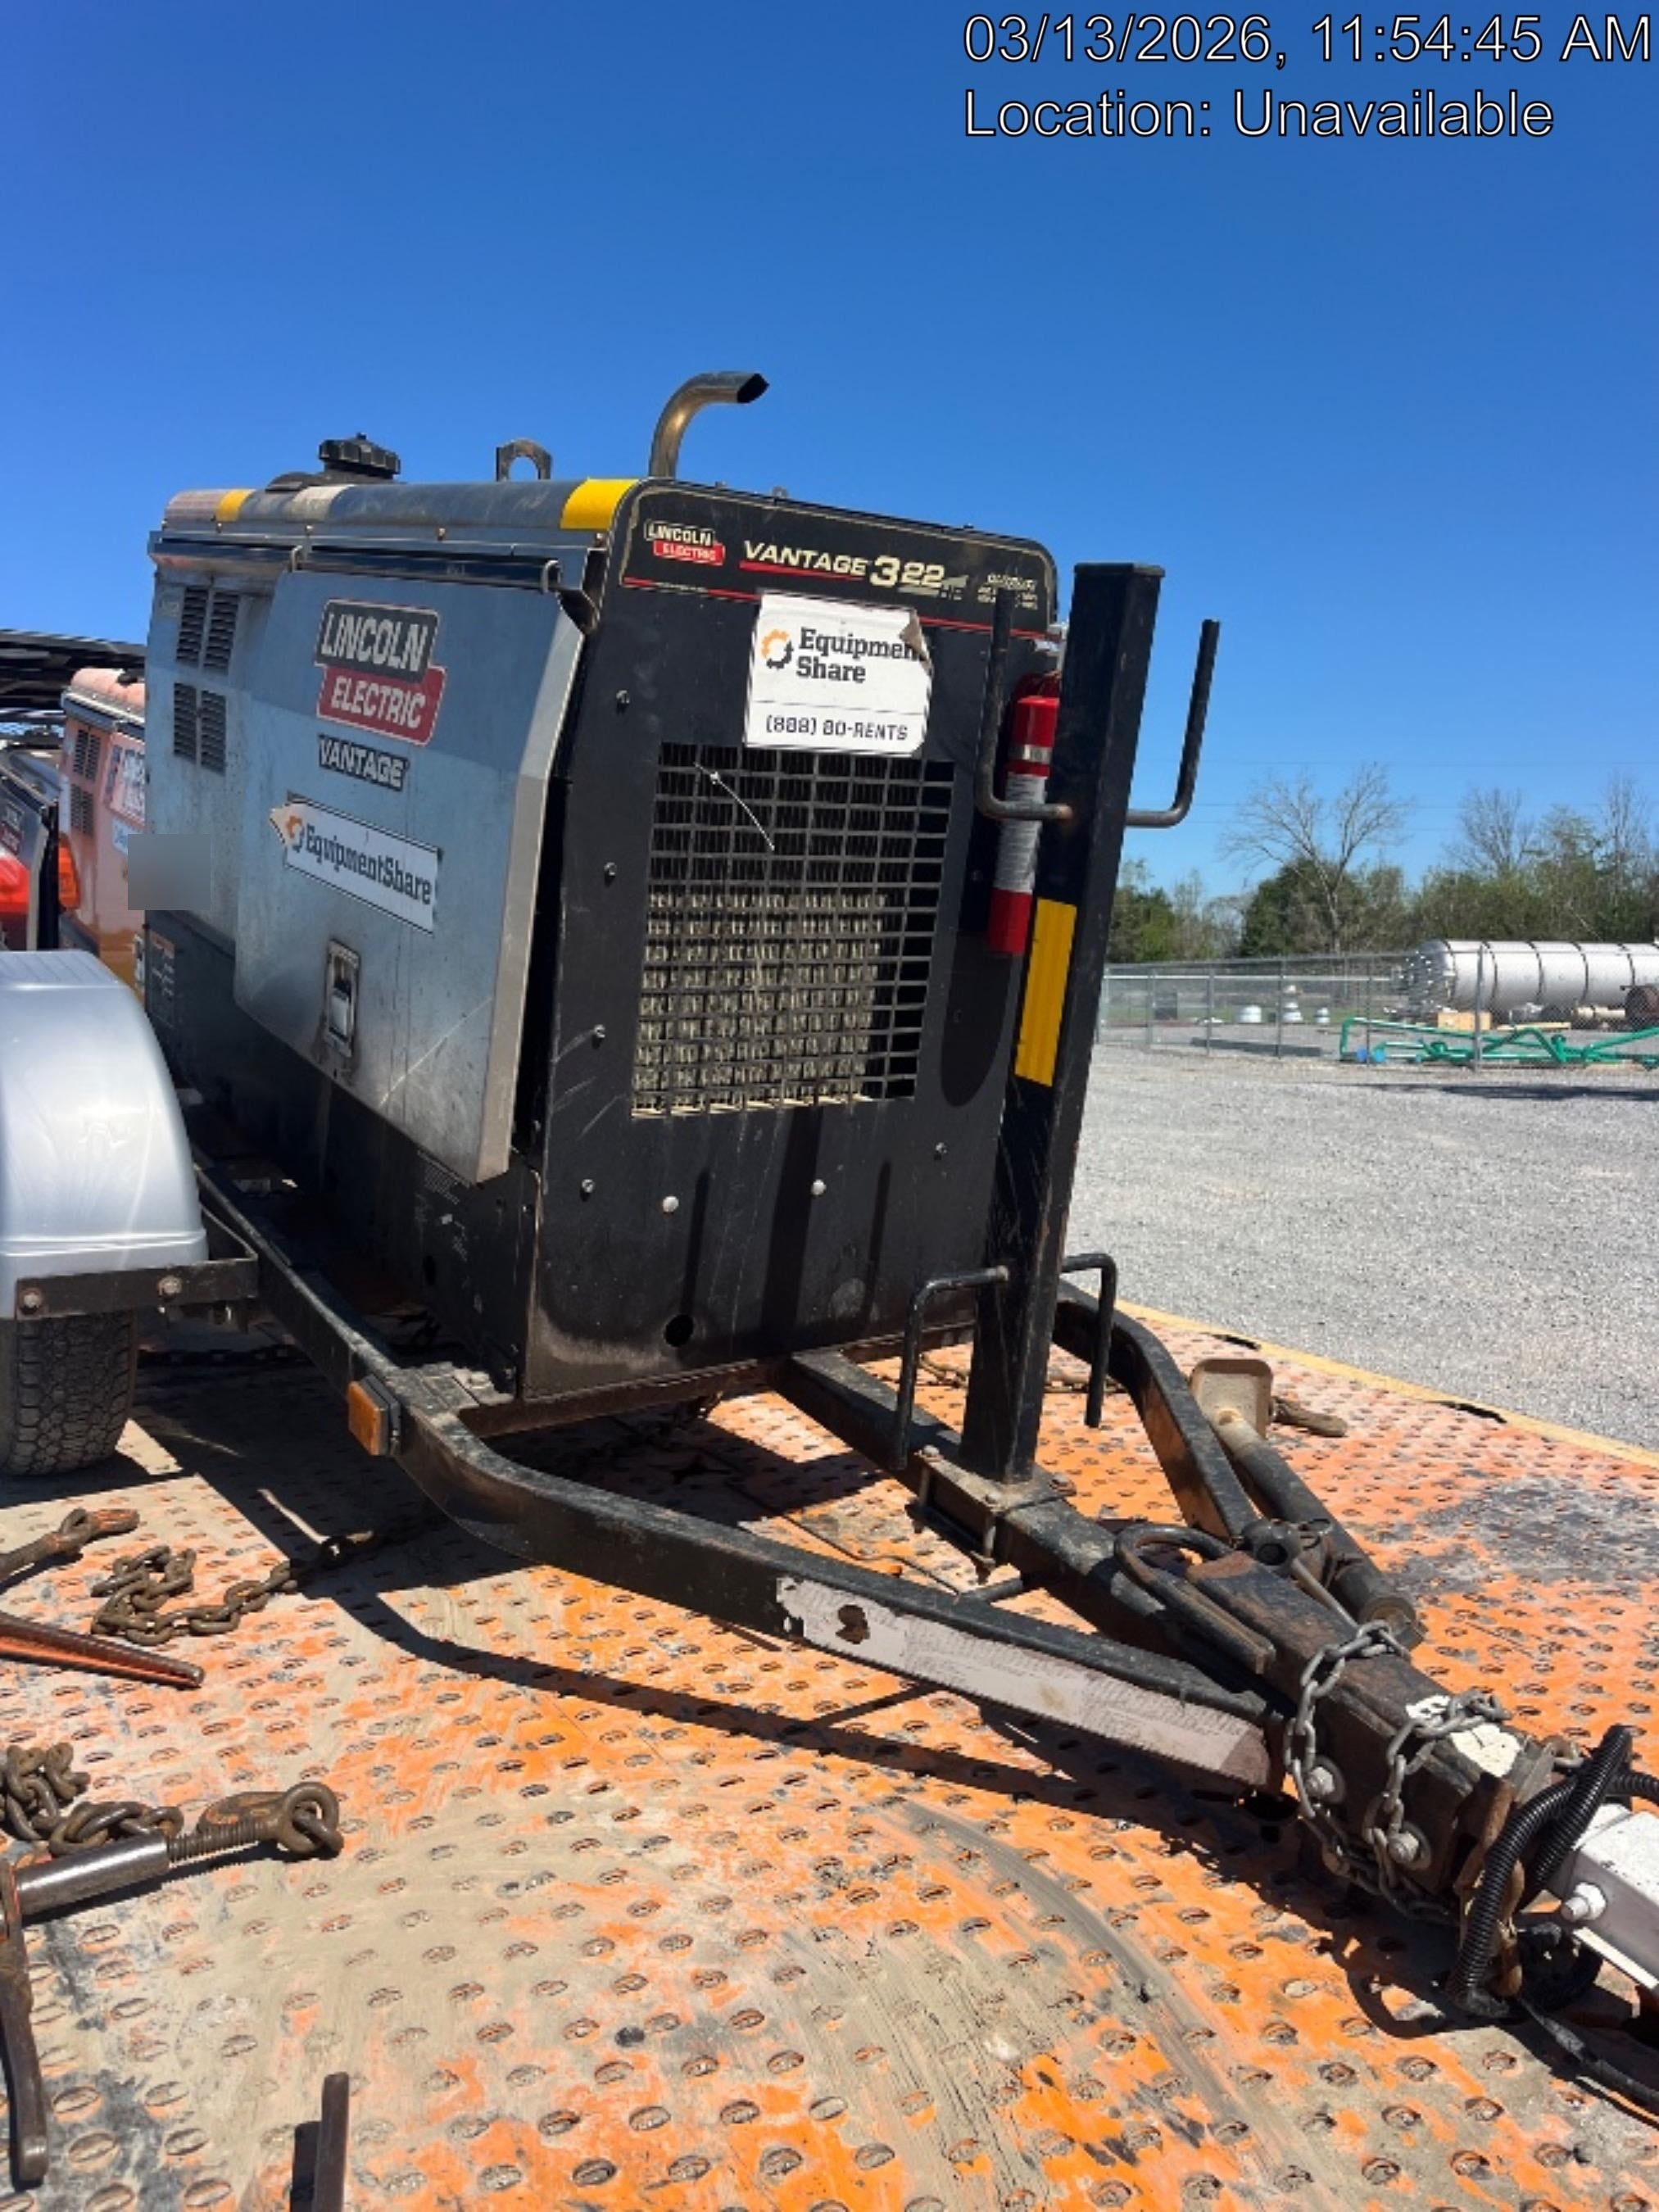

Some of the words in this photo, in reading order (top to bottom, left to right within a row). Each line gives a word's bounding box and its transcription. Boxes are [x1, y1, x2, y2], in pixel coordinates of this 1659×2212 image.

[648, 522, 712, 546] LINCOLN
[662, 542, 718, 562] ELECTRIC
[744, 539, 871, 577] VANTAGE
[869, 555, 945, 589] 322
[321, 613, 428, 673] LINCOLN
[796, 655, 867, 684] Share
[330, 675, 426, 729] ELECTRIC
[765, 714, 818, 736] (888)
[319, 738, 404, 788] VANTAGE
[306, 822, 432, 905] EquipmentShare
